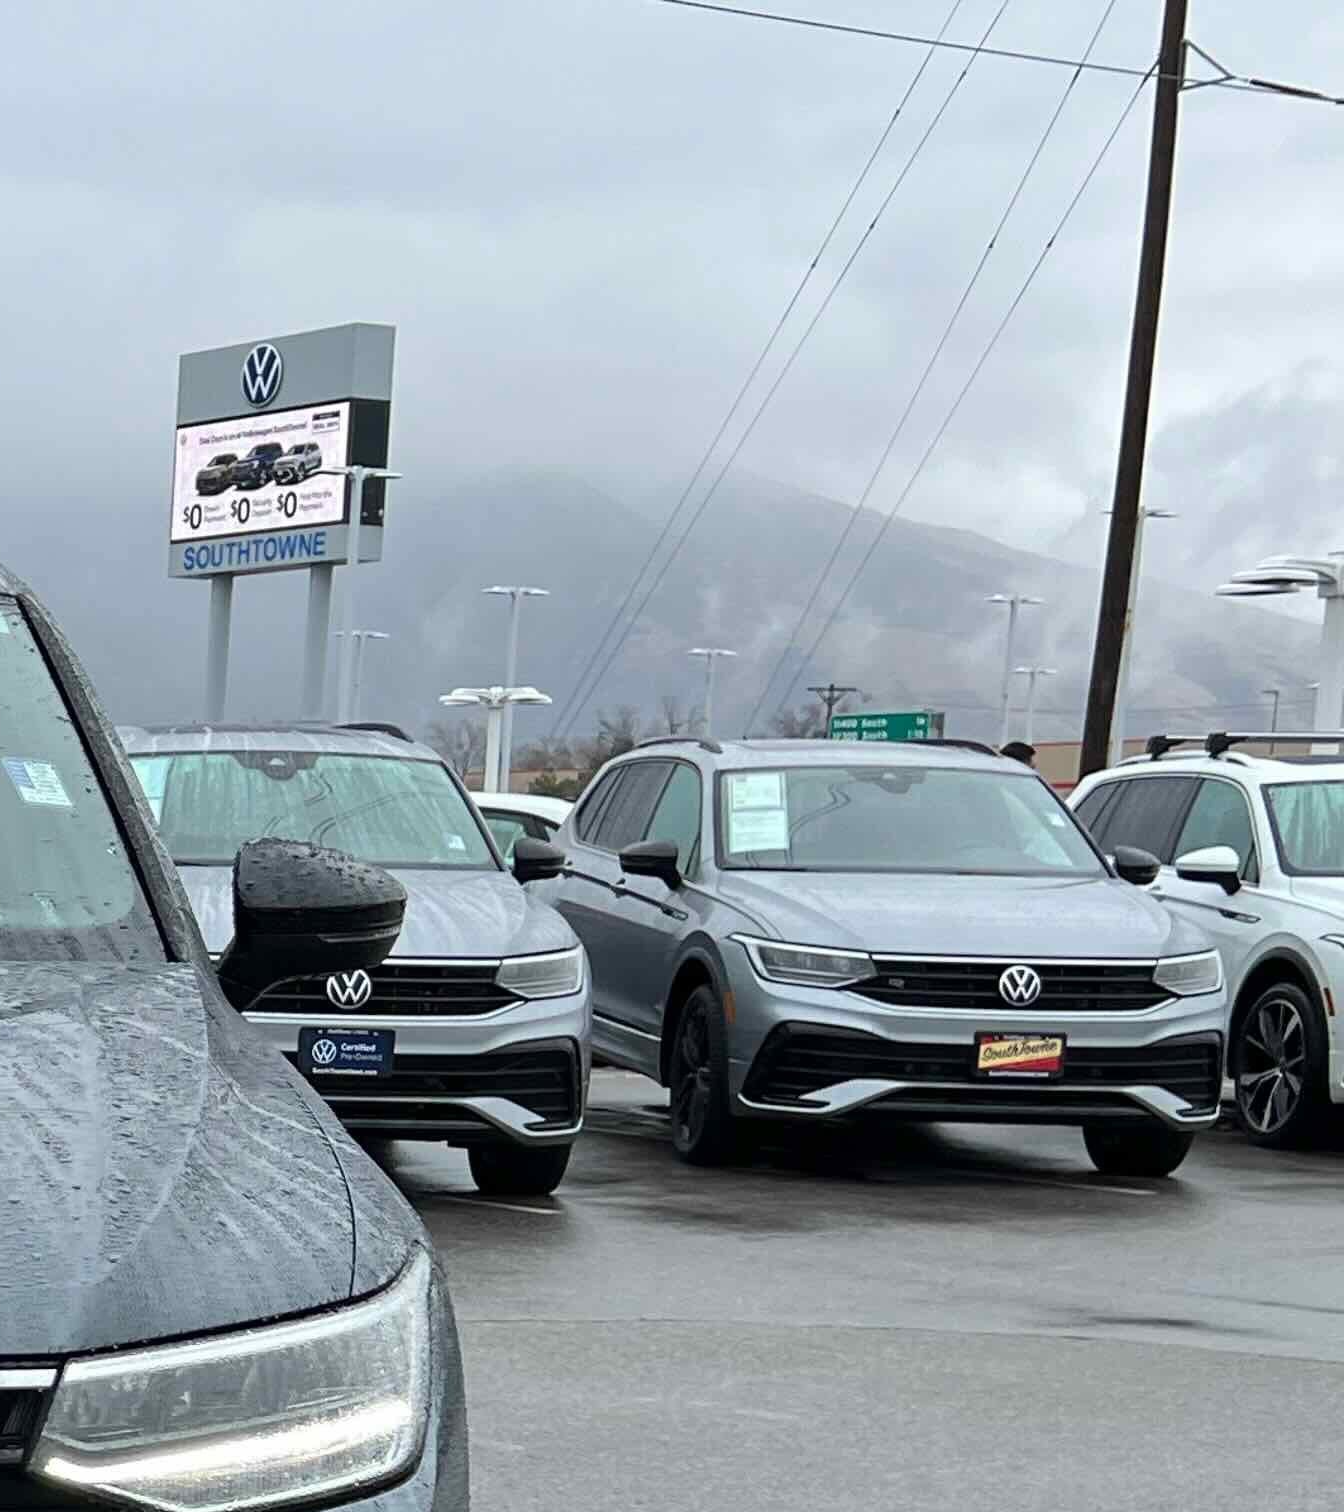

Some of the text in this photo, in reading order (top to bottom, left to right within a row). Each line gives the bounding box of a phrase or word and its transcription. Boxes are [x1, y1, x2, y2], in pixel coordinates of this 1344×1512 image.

[183, 504, 202, 530] $0
[231, 497, 250, 524] $0
[277, 491, 297, 518] $0
[184, 531, 326, 570] SOUTHTOWNE
[340, 1053, 383, 1062] Pre-Owned
[341, 1043, 376, 1052] Certified
